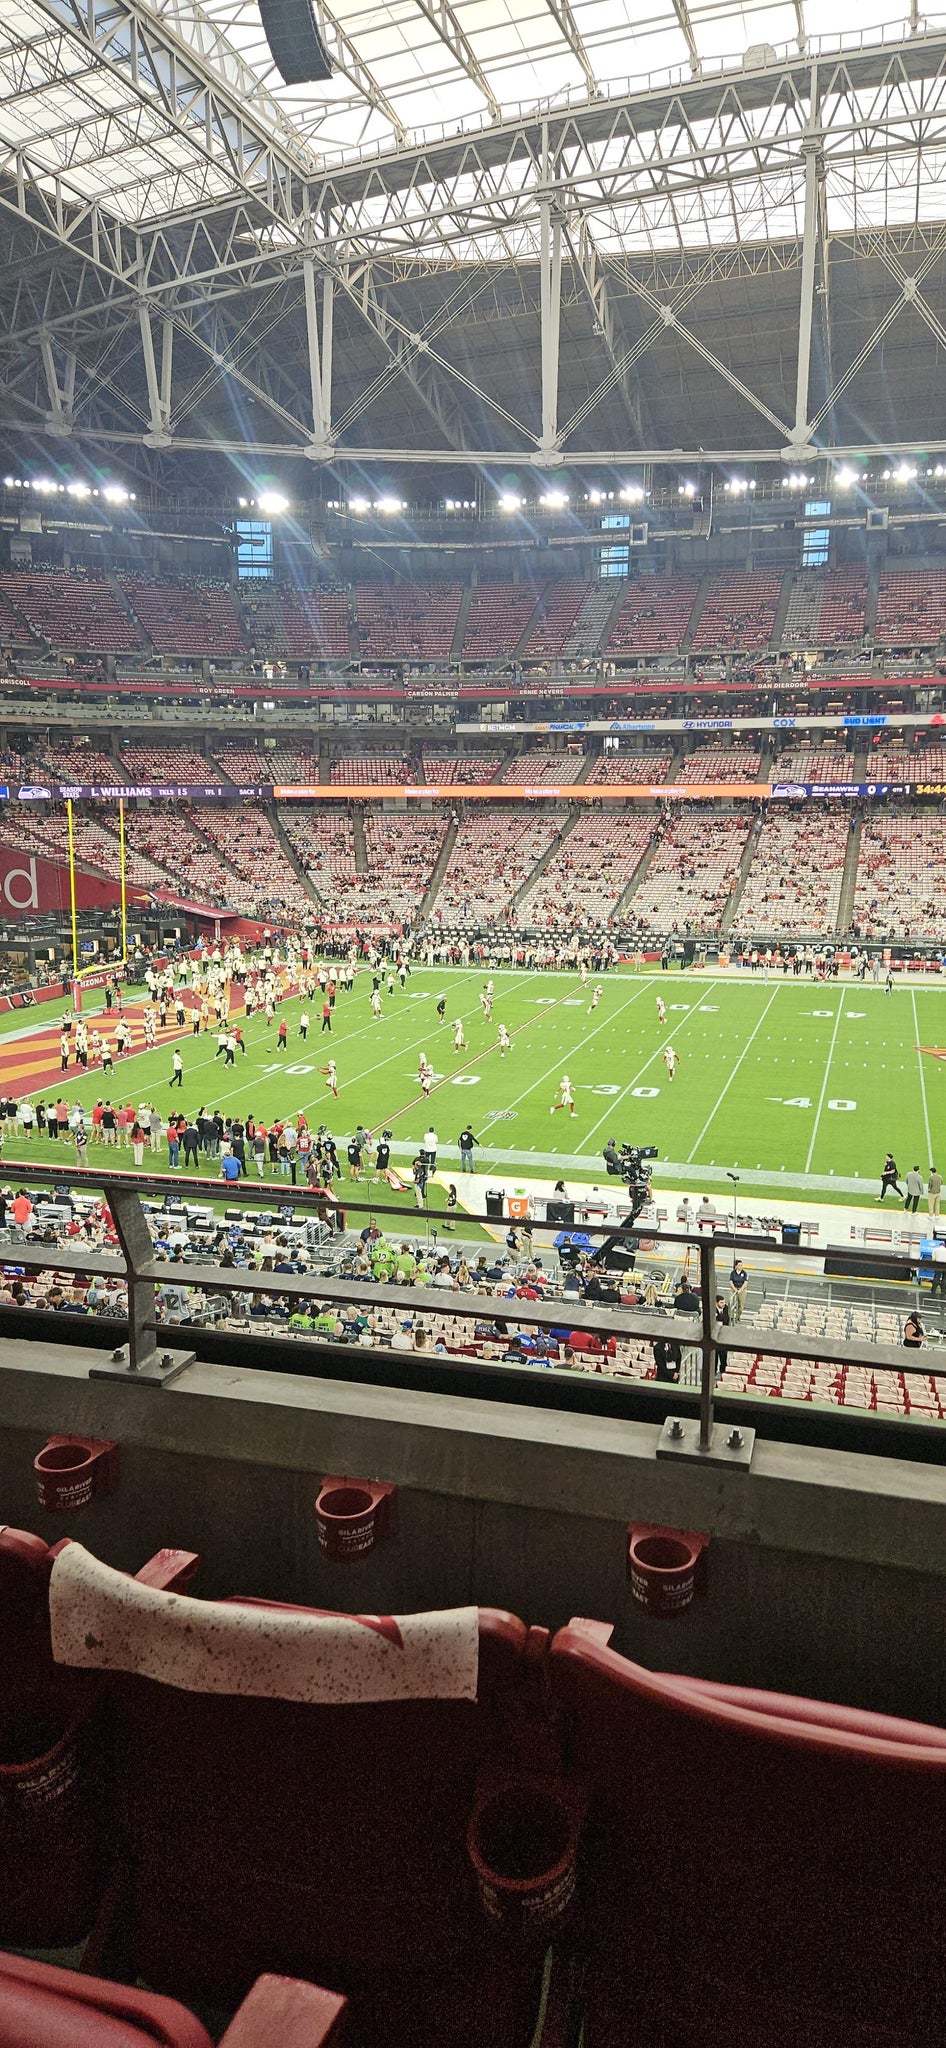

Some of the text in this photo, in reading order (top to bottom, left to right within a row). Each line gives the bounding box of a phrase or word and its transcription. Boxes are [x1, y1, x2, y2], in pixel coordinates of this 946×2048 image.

[696, 720, 733, 728] HYUNDAI
[773, 718, 796, 727] COX
[844, 716, 887, 725] BUD LIGHT
[91, 787, 99, 796] L.
[100, 787, 152, 796] WILLIAMS
[867, 785, 876, 794] 0
[904, 785, 910, 794] 1
[0, 857, 39, 909] d
[591, 1084, 661, 1098] 30
[782, 1097, 857, 1110] 40
[164, 1294, 179, 1310] 12
